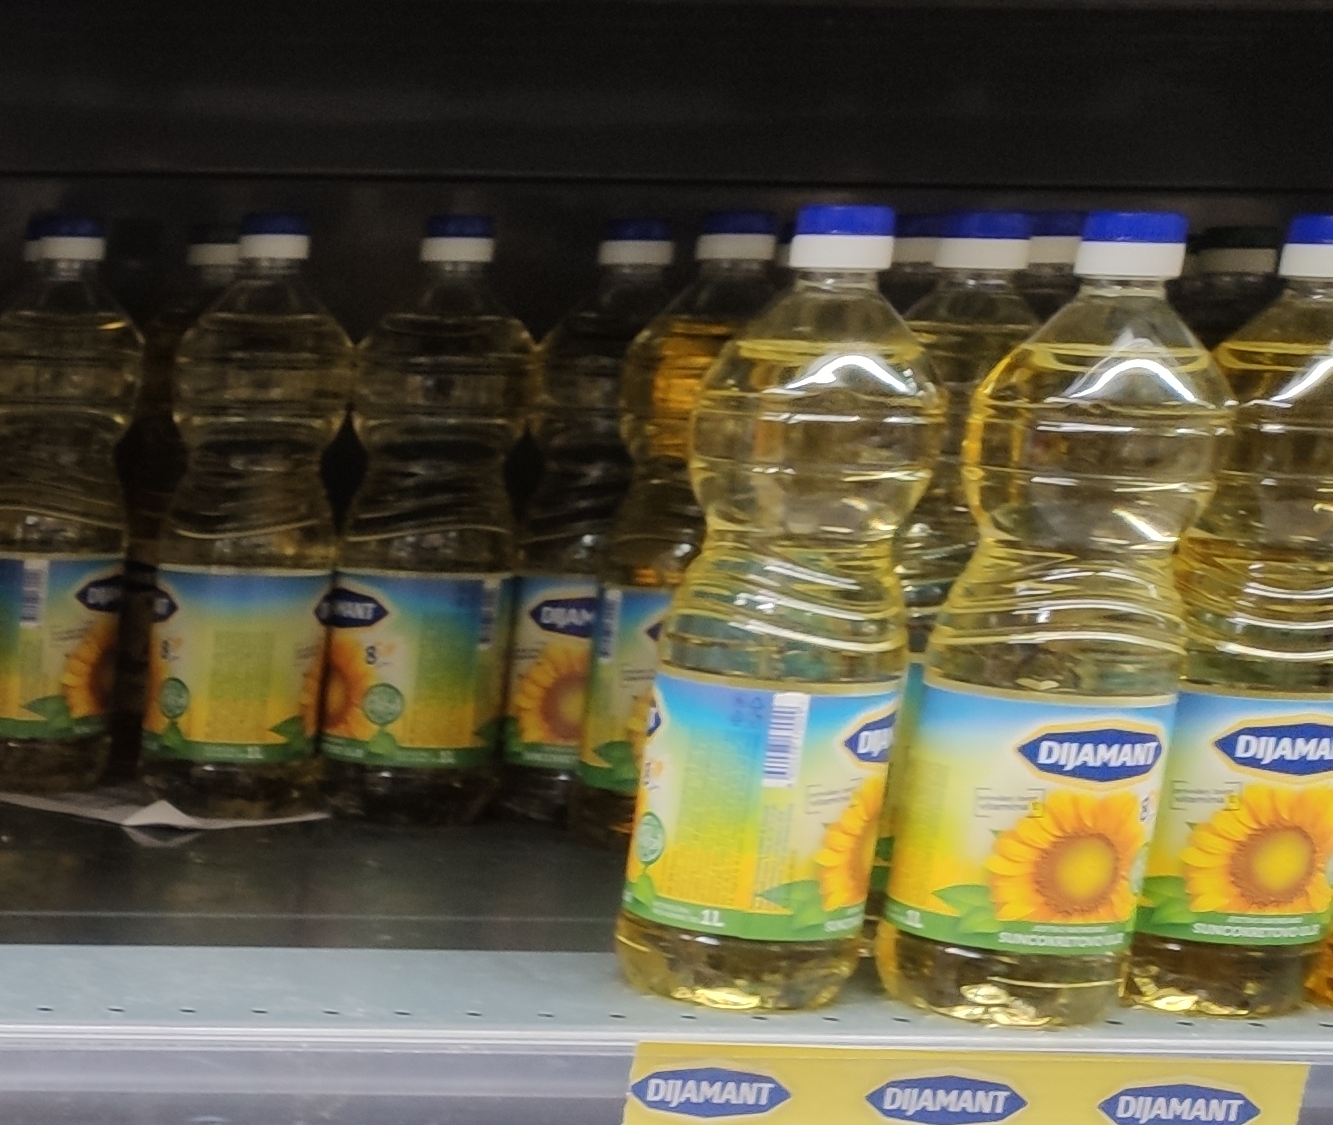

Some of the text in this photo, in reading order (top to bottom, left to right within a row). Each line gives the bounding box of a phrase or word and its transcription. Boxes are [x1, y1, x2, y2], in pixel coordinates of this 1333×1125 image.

[1037, 741, 1158, 771] DIJAMANT
[1235, 735, 1333, 765] DIJAMA
[646, 1078, 776, 1107] DIJAMANT
[882, 1087, 1008, 1116] DIJAMANT
[1116, 1096, 1244, 1124] DIJAMANT
